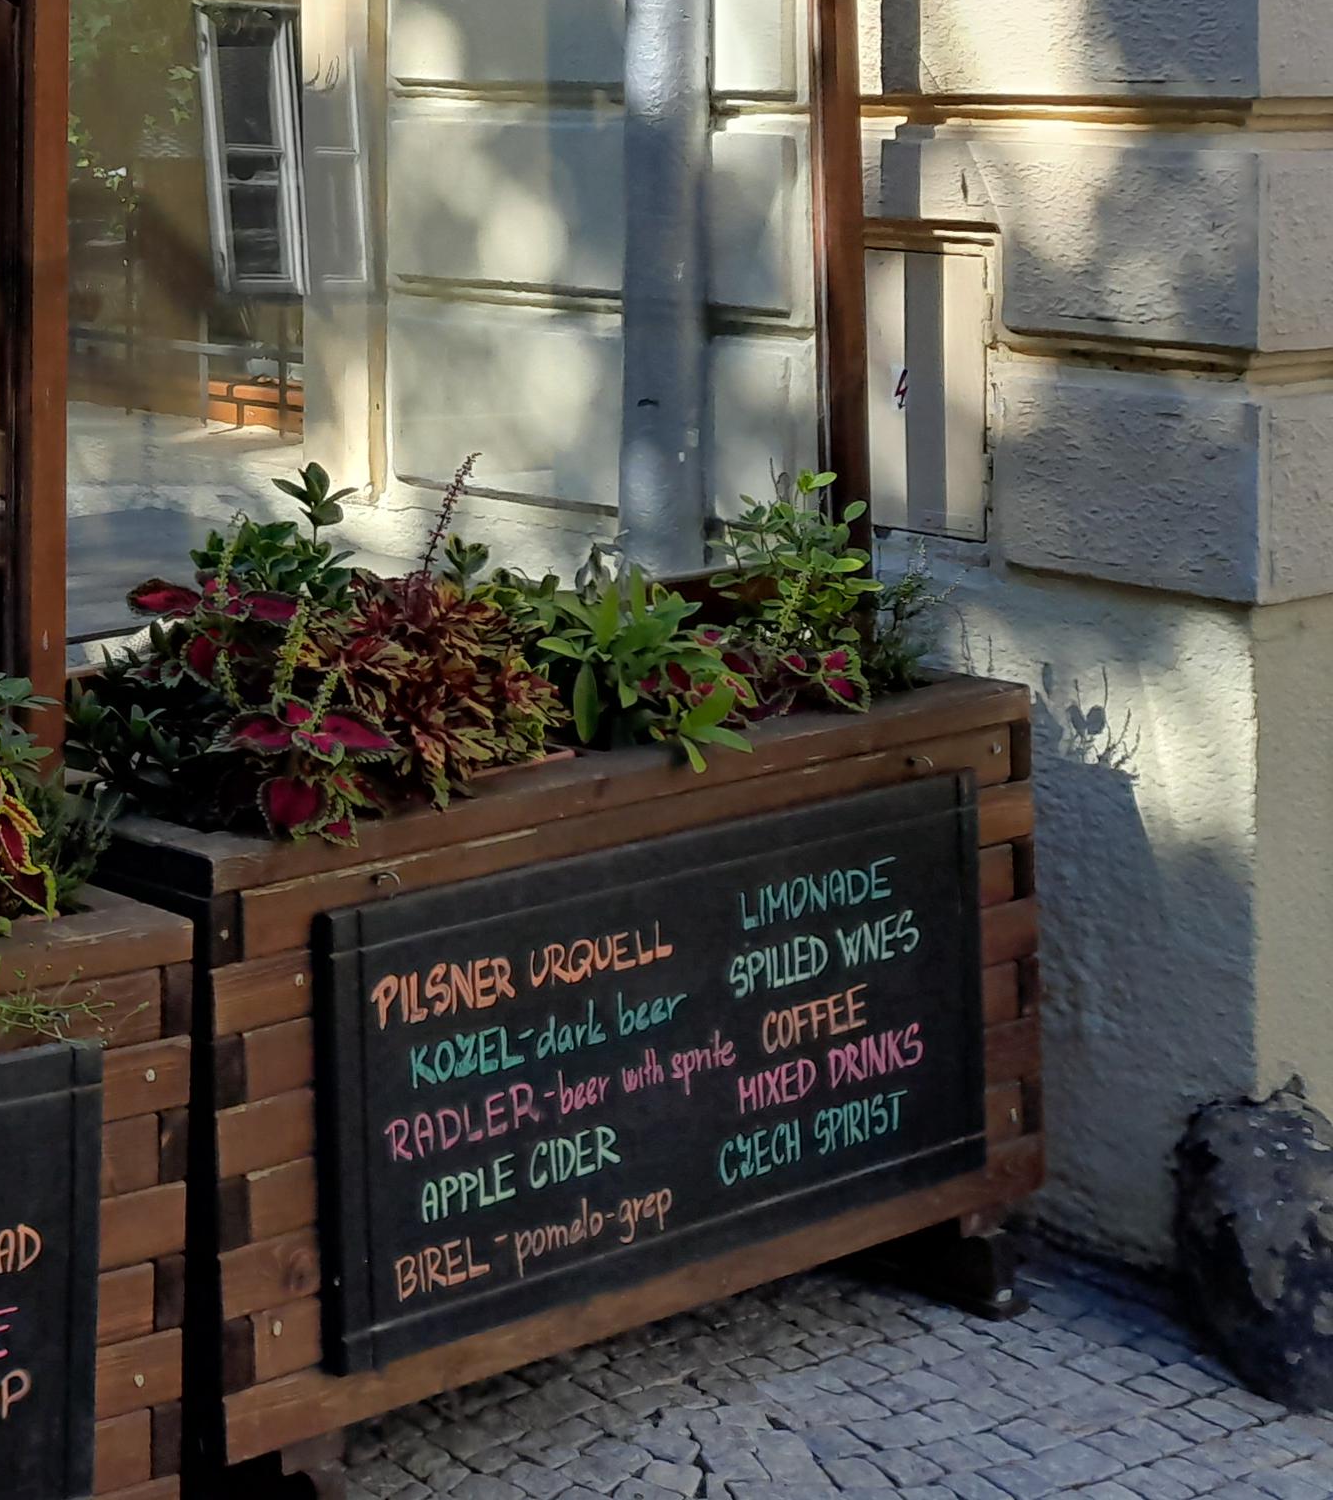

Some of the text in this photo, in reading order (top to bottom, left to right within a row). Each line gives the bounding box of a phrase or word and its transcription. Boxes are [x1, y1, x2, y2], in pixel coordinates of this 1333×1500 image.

[740, 856, 896, 930] LIMONADE
[371, 920, 674, 1030] PILSNER URQUELL
[729, 934, 828, 999] SPILLED
[618, 991, 687, 1036] beer
[762, 983, 868, 1054] COFFEE
[384, 1082, 541, 1162] RADLER
[621, 1047, 665, 1094] with
[671, 1029, 736, 1096] sprite
[737, 1022, 924, 1114] MIXED DRINKS
[421, 1125, 621, 1223] APPLE CIDER
[719, 1090, 908, 1186] CZECH SPIRIST
[394, 1237, 490, 1302] BIREL
